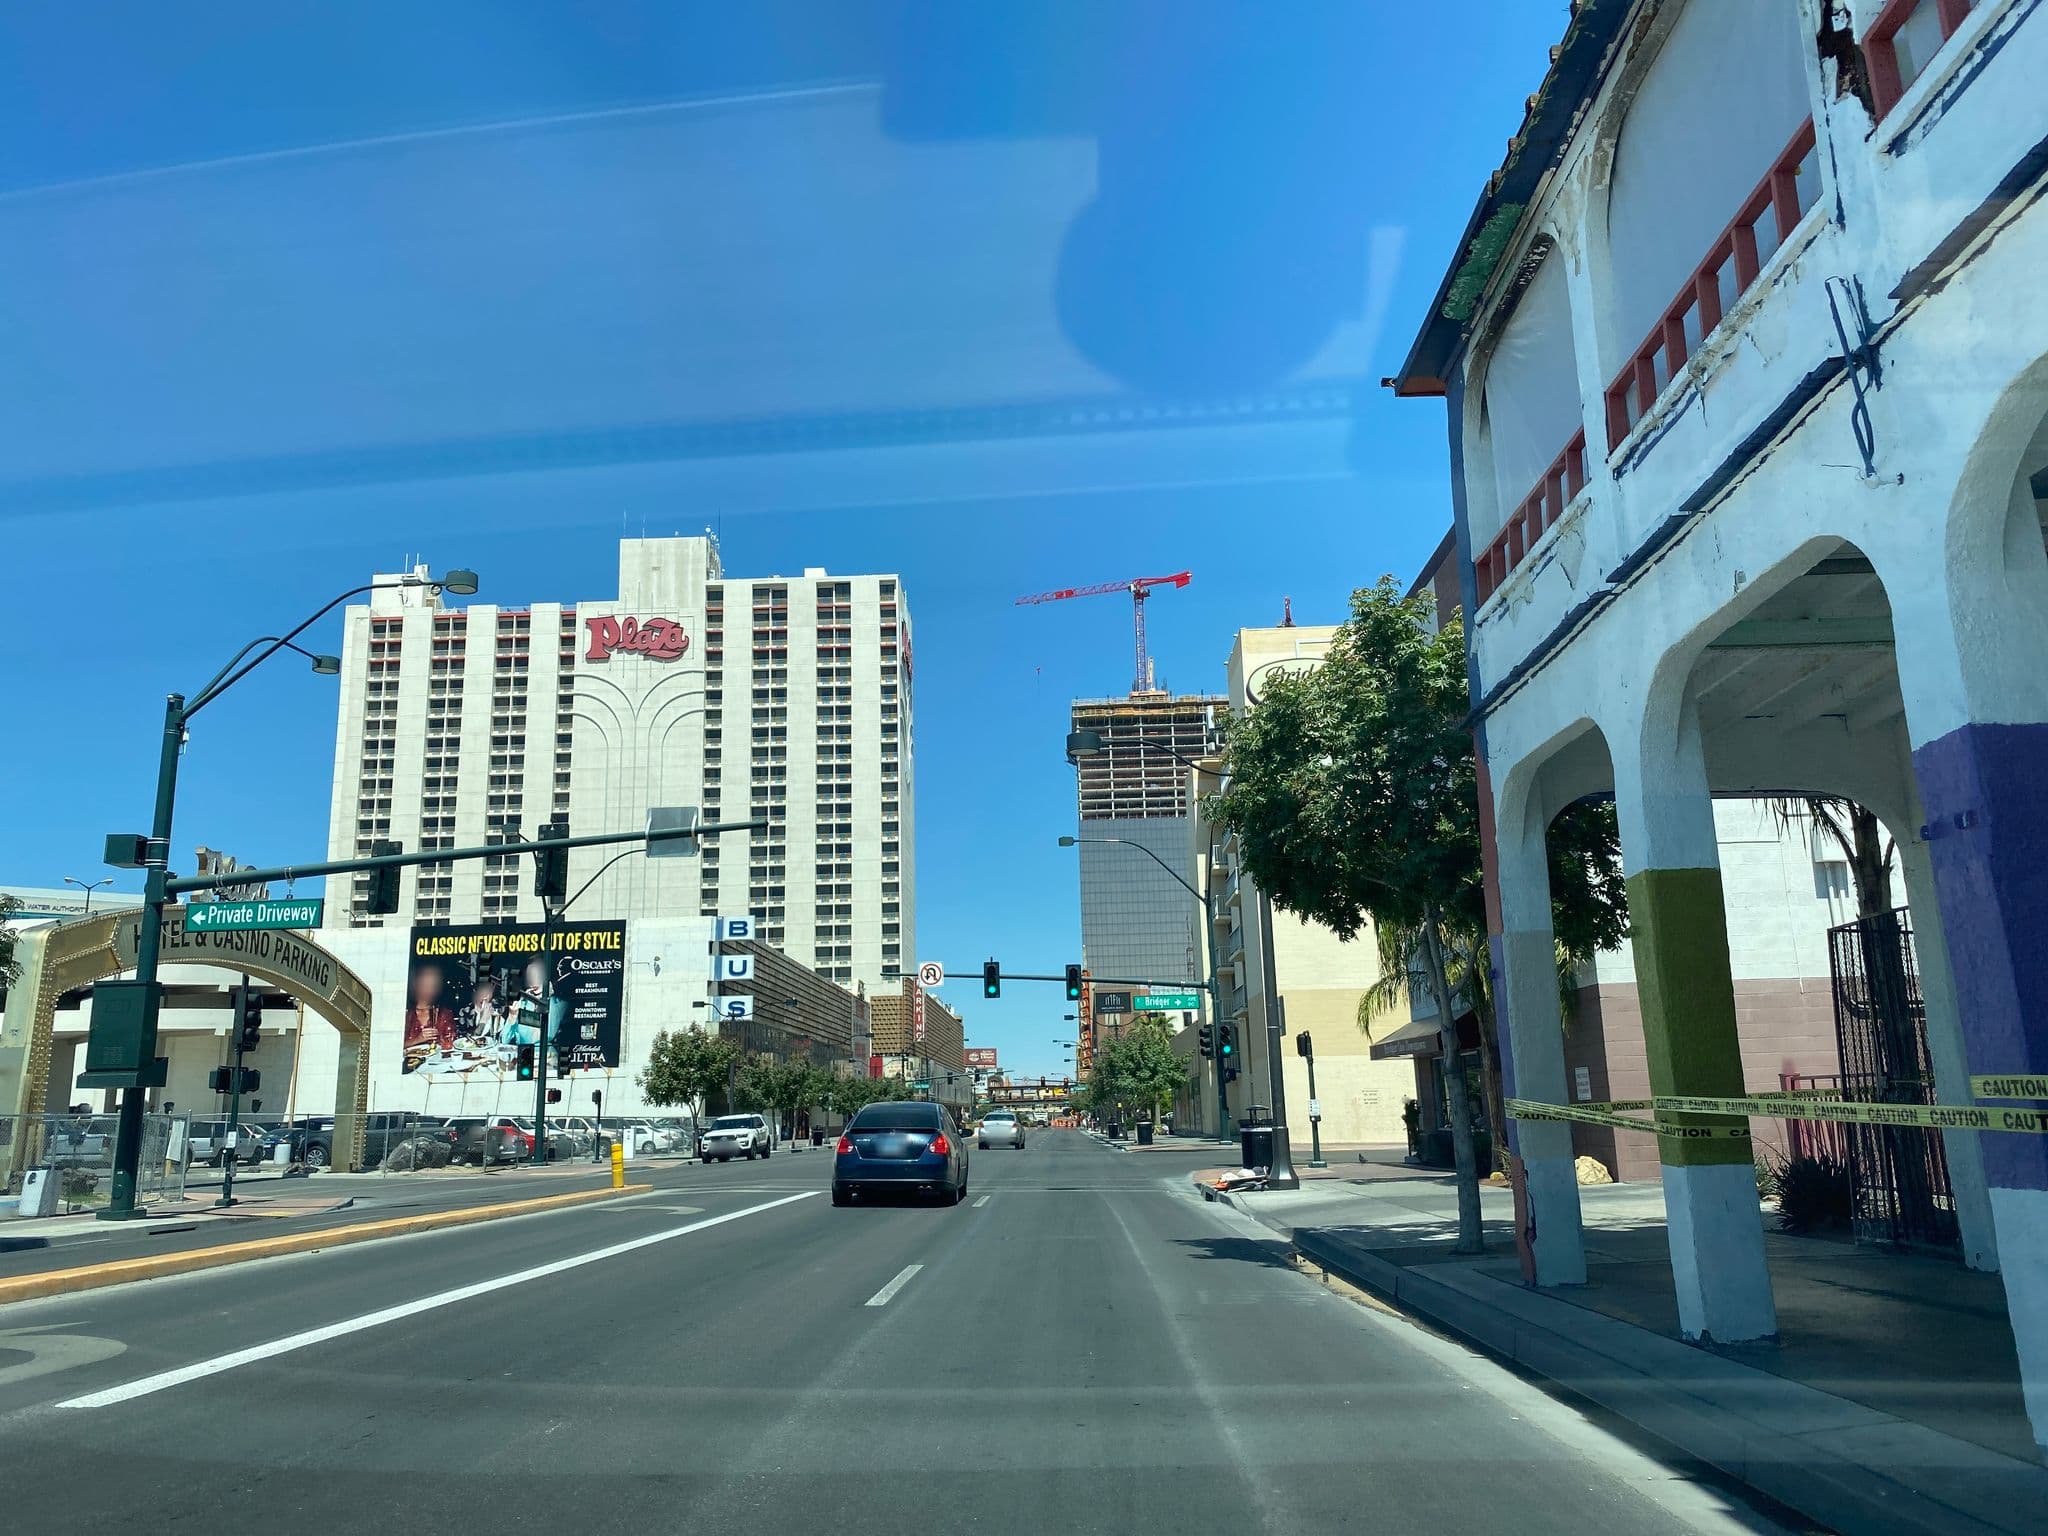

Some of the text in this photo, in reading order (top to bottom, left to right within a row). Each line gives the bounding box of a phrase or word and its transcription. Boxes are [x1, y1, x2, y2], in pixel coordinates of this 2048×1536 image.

[585, 615, 690, 663] Plaza
[207, 903, 317, 925] Private Driveway
[416, 937, 466, 956] CLASSIC
[508, 933, 539, 952] GOES
[566, 932, 581, 951] OF
[583, 931, 621, 950] STYLE
[213, 929, 270, 958] CASINO
[273, 936, 330, 988] PARKING
[727, 920, 749, 1018] BUS
[1144, 997, 1170, 1009] Bridger
[1982, 1079, 2048, 1097] CAUTION
[1725, 1101, 1760, 1114] CAUTION
[1766, 1103, 1806, 1116] CAUTION
[1814, 1105, 1858, 1118] CAUTION
[1867, 1107, 1918, 1123] CAUTION
[1929, 1110, 1989, 1127] CAUTION
[2003, 1112, 2048, 1131] CAUT
